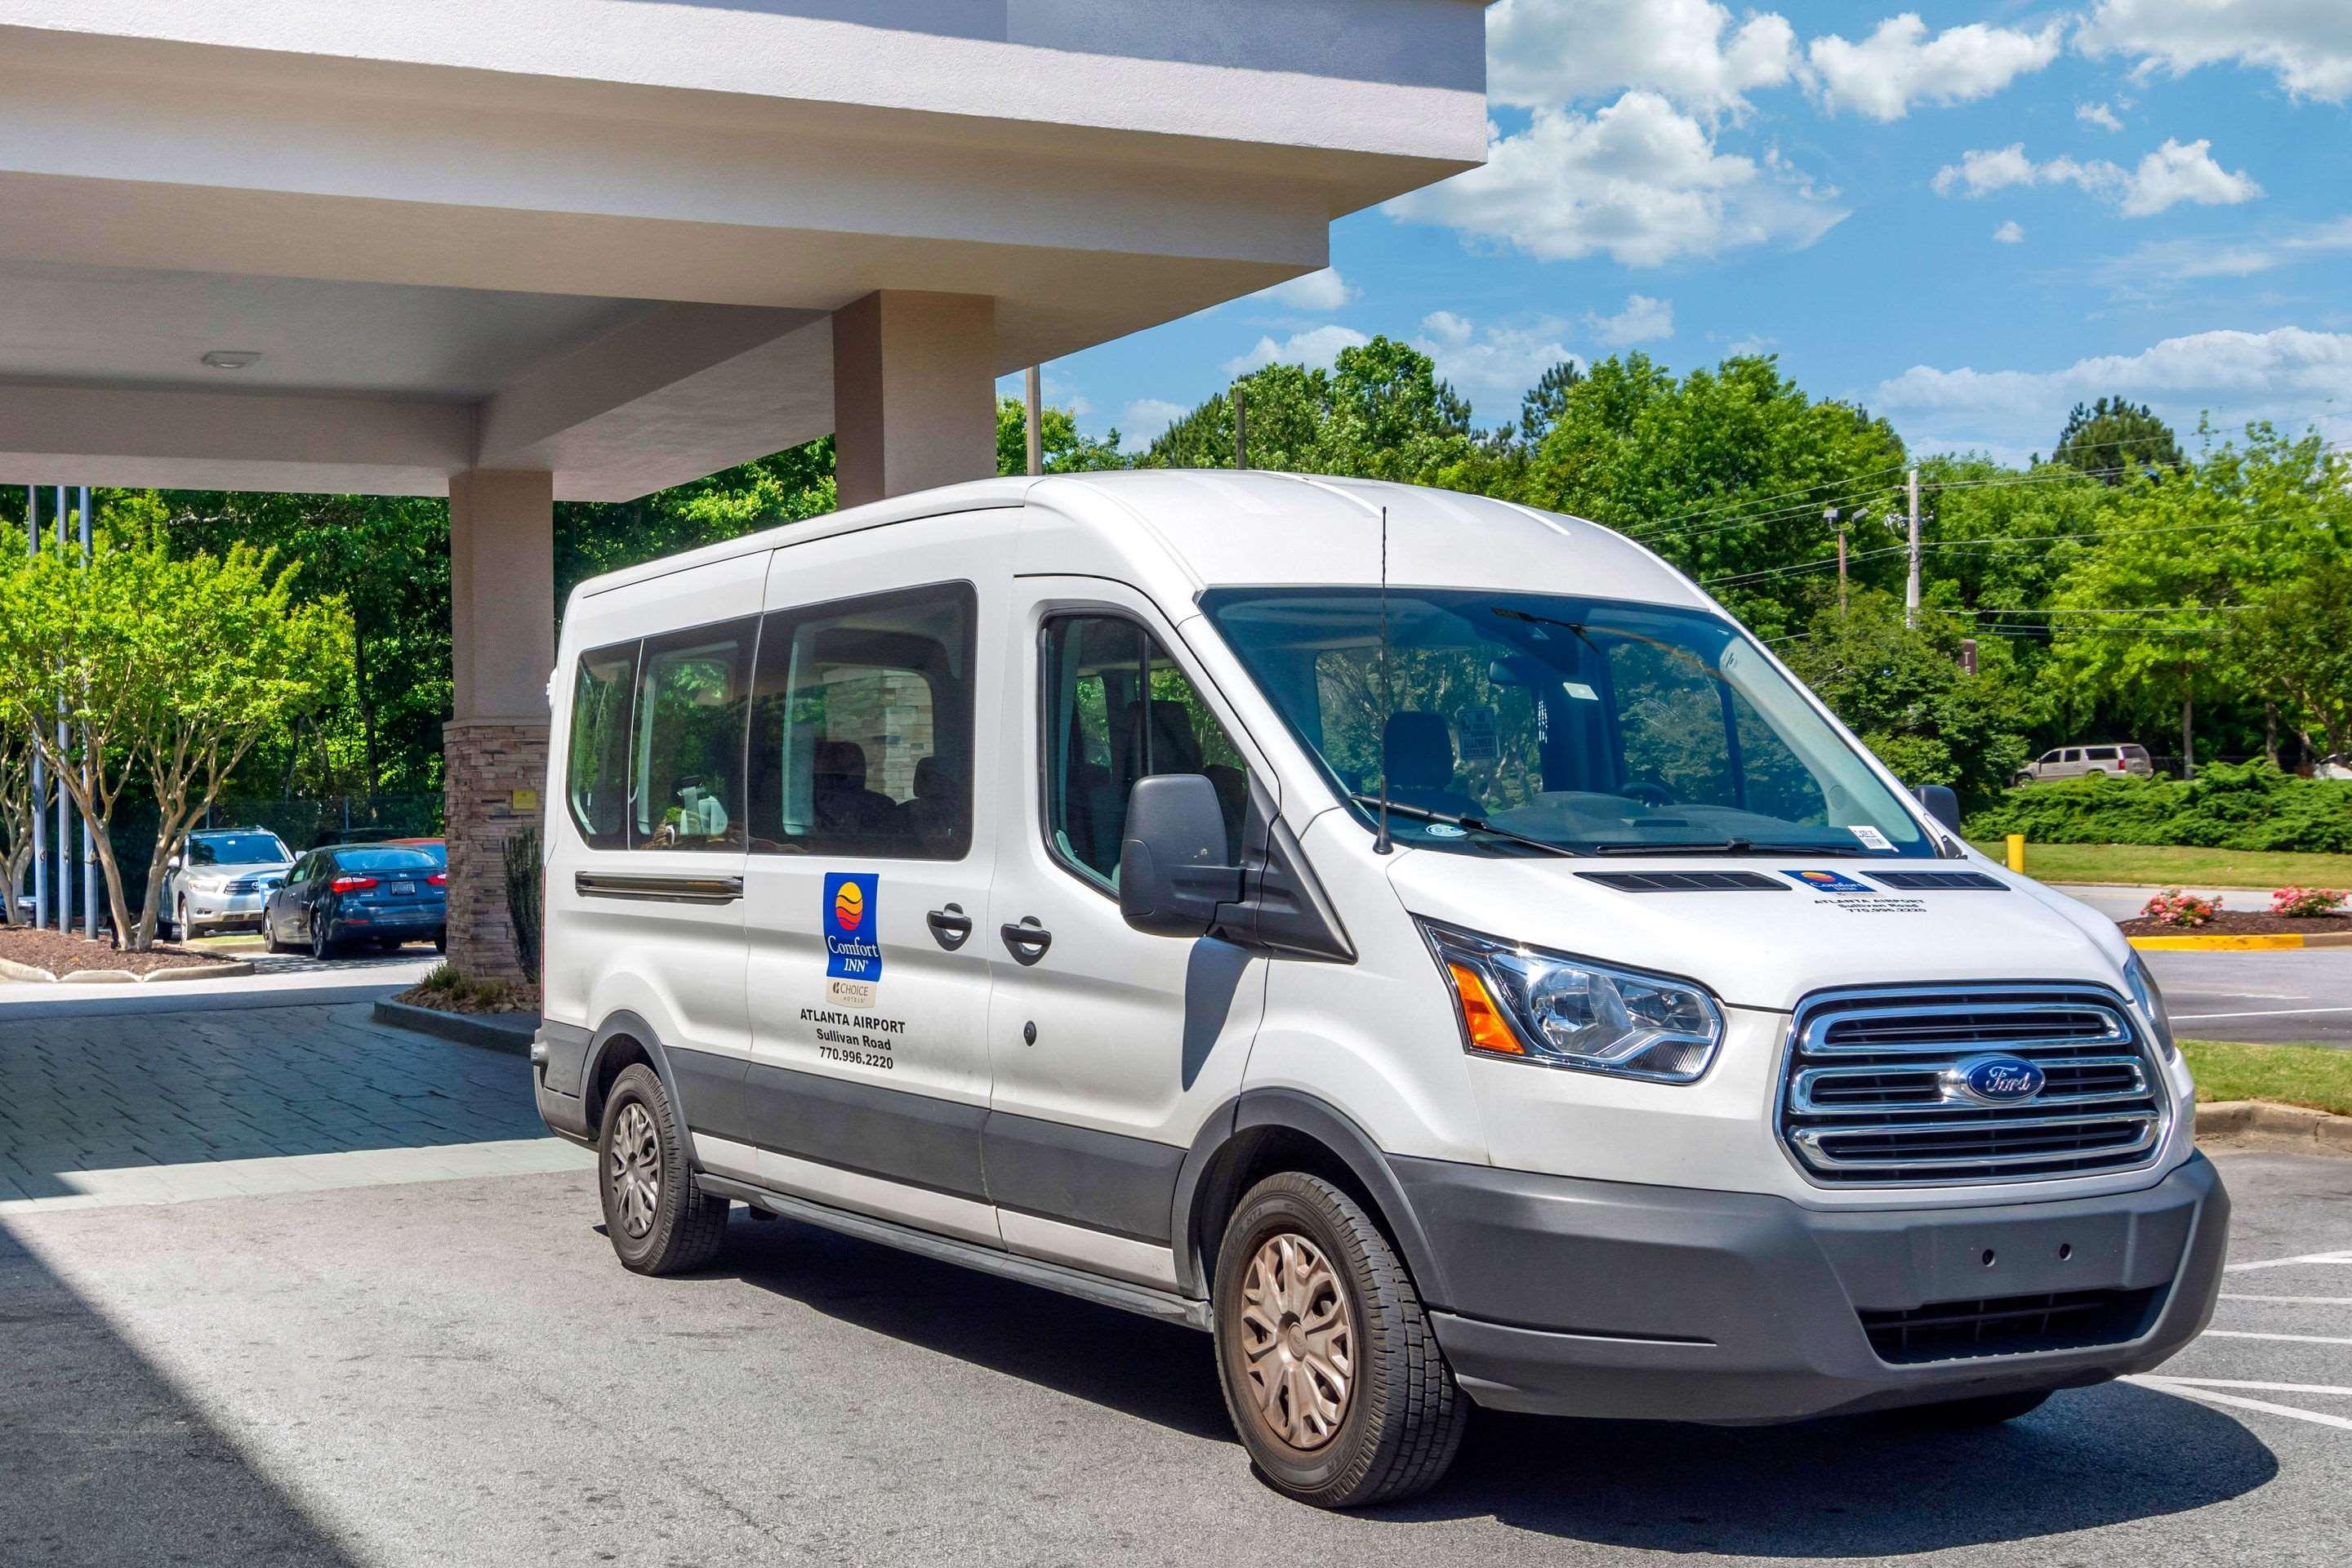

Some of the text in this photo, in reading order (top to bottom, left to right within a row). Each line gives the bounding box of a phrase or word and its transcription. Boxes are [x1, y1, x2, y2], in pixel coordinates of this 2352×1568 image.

[827, 936, 879, 958] Comfort
[840, 982, 868, 996] CHOICE
[800, 1009, 906, 1034] ATLANTA AIRPORT
[817, 1028, 892, 1051] Sullivan Road
[819, 1046, 893, 1070] 770.996.2220
[1985, 1066, 2031, 1093] Ford
